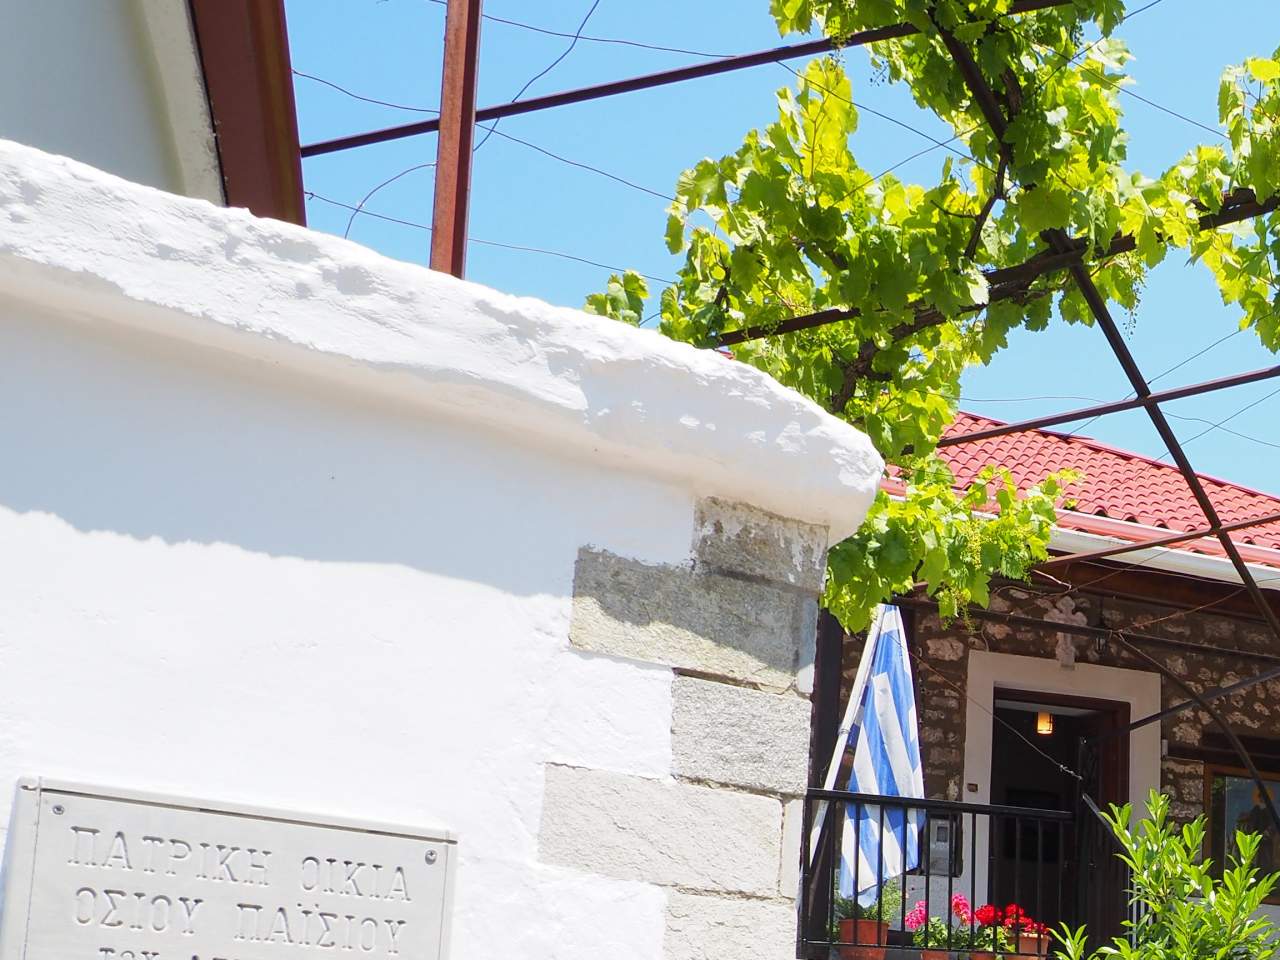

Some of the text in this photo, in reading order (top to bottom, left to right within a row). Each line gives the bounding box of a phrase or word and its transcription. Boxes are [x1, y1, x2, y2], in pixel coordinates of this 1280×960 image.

[67, 825, 413, 903] ΠΑΤΡΙΚΗ ΟΙΚΙΑ
[74, 886, 407, 955] ΟΣΙΟΥ ΠΑΪΣΙΟΥ
